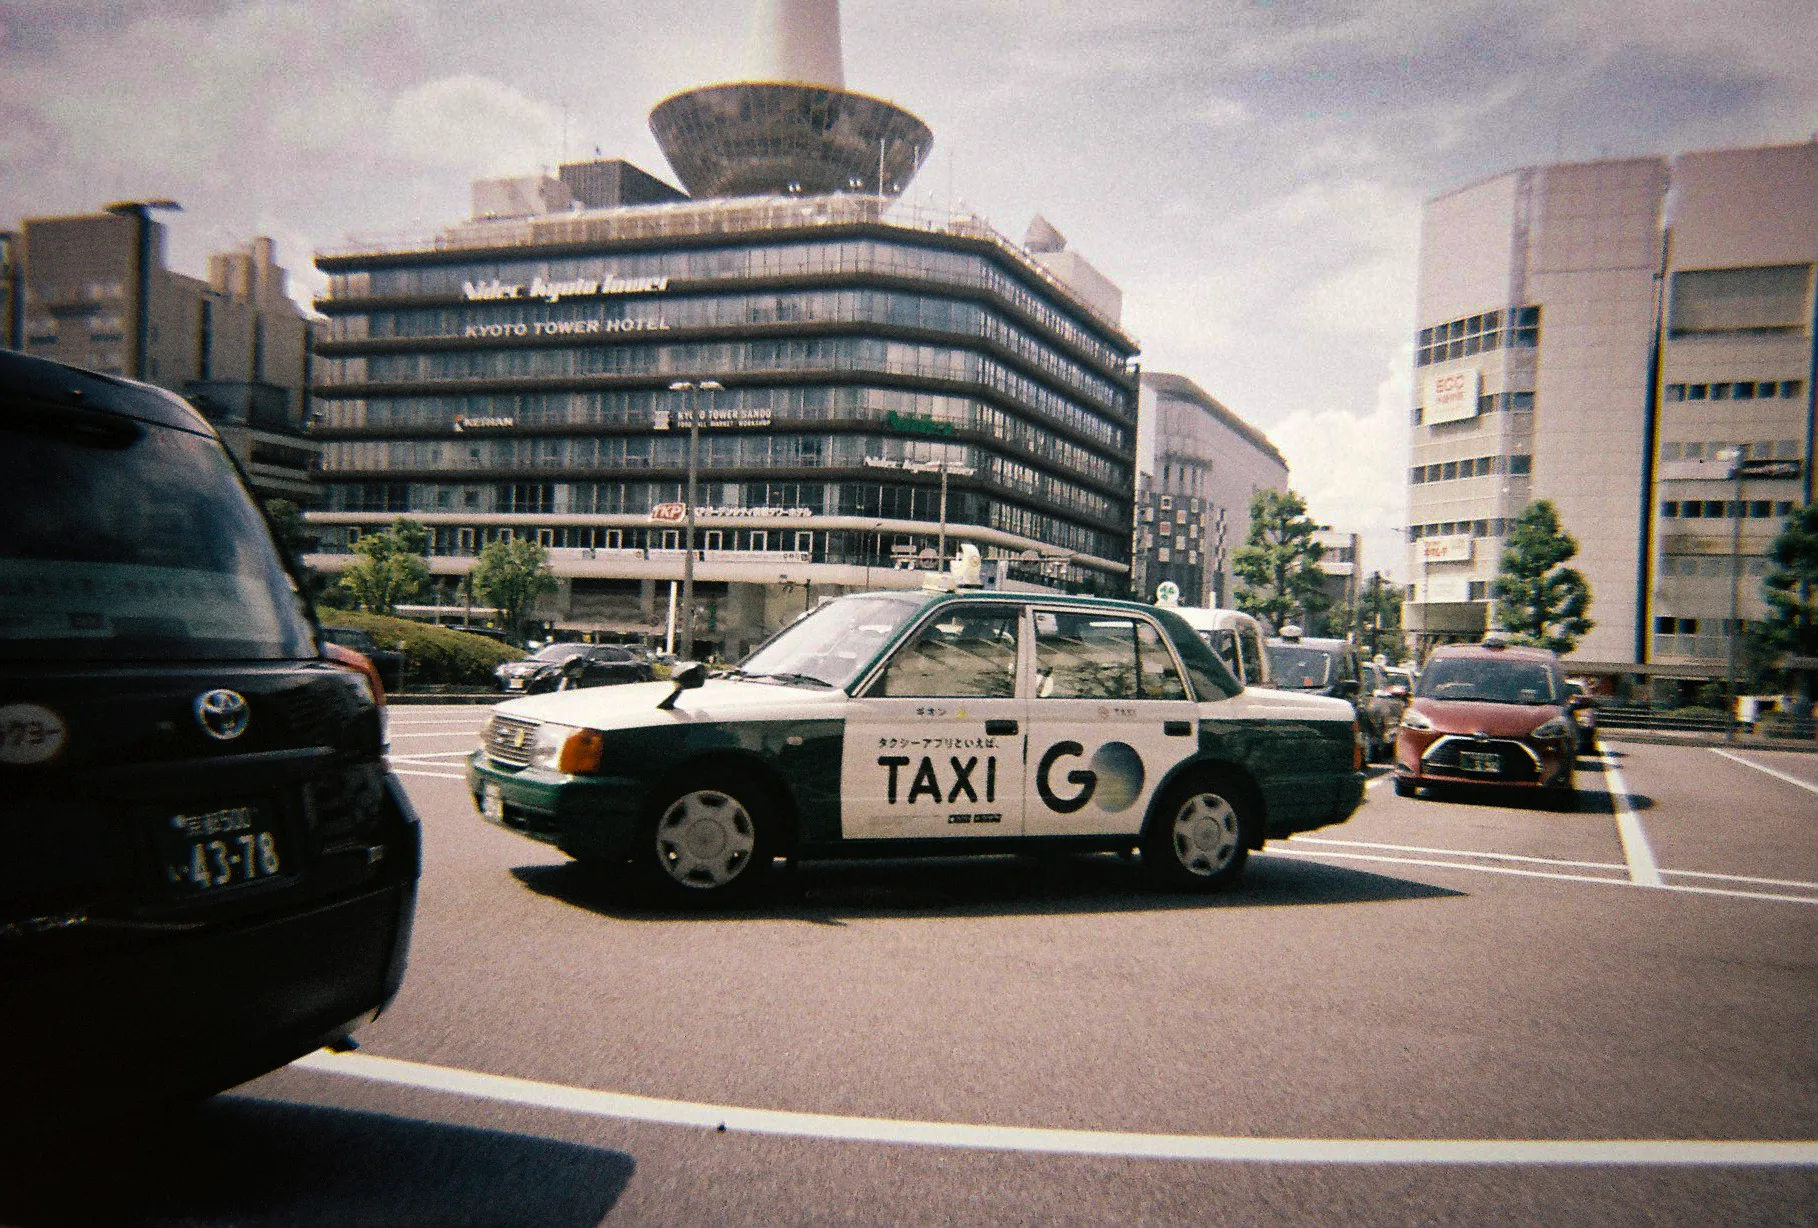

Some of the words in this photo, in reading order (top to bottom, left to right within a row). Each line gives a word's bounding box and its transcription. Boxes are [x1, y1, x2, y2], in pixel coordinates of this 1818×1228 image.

[465, 323, 528, 338] KYOTO
[533, 320, 600, 335] TOWER
[606, 317, 670, 332] HOTEL
[677, 410, 706, 420] KYOO
[708, 409, 738, 419] TOWER
[742, 408, 772, 419] SANDO
[652, 505, 682, 519] TKP
[877, 756, 996, 804] TAXI
[1036, 741, 1145, 813] GO
[190, 831, 281, 889] 43-78
